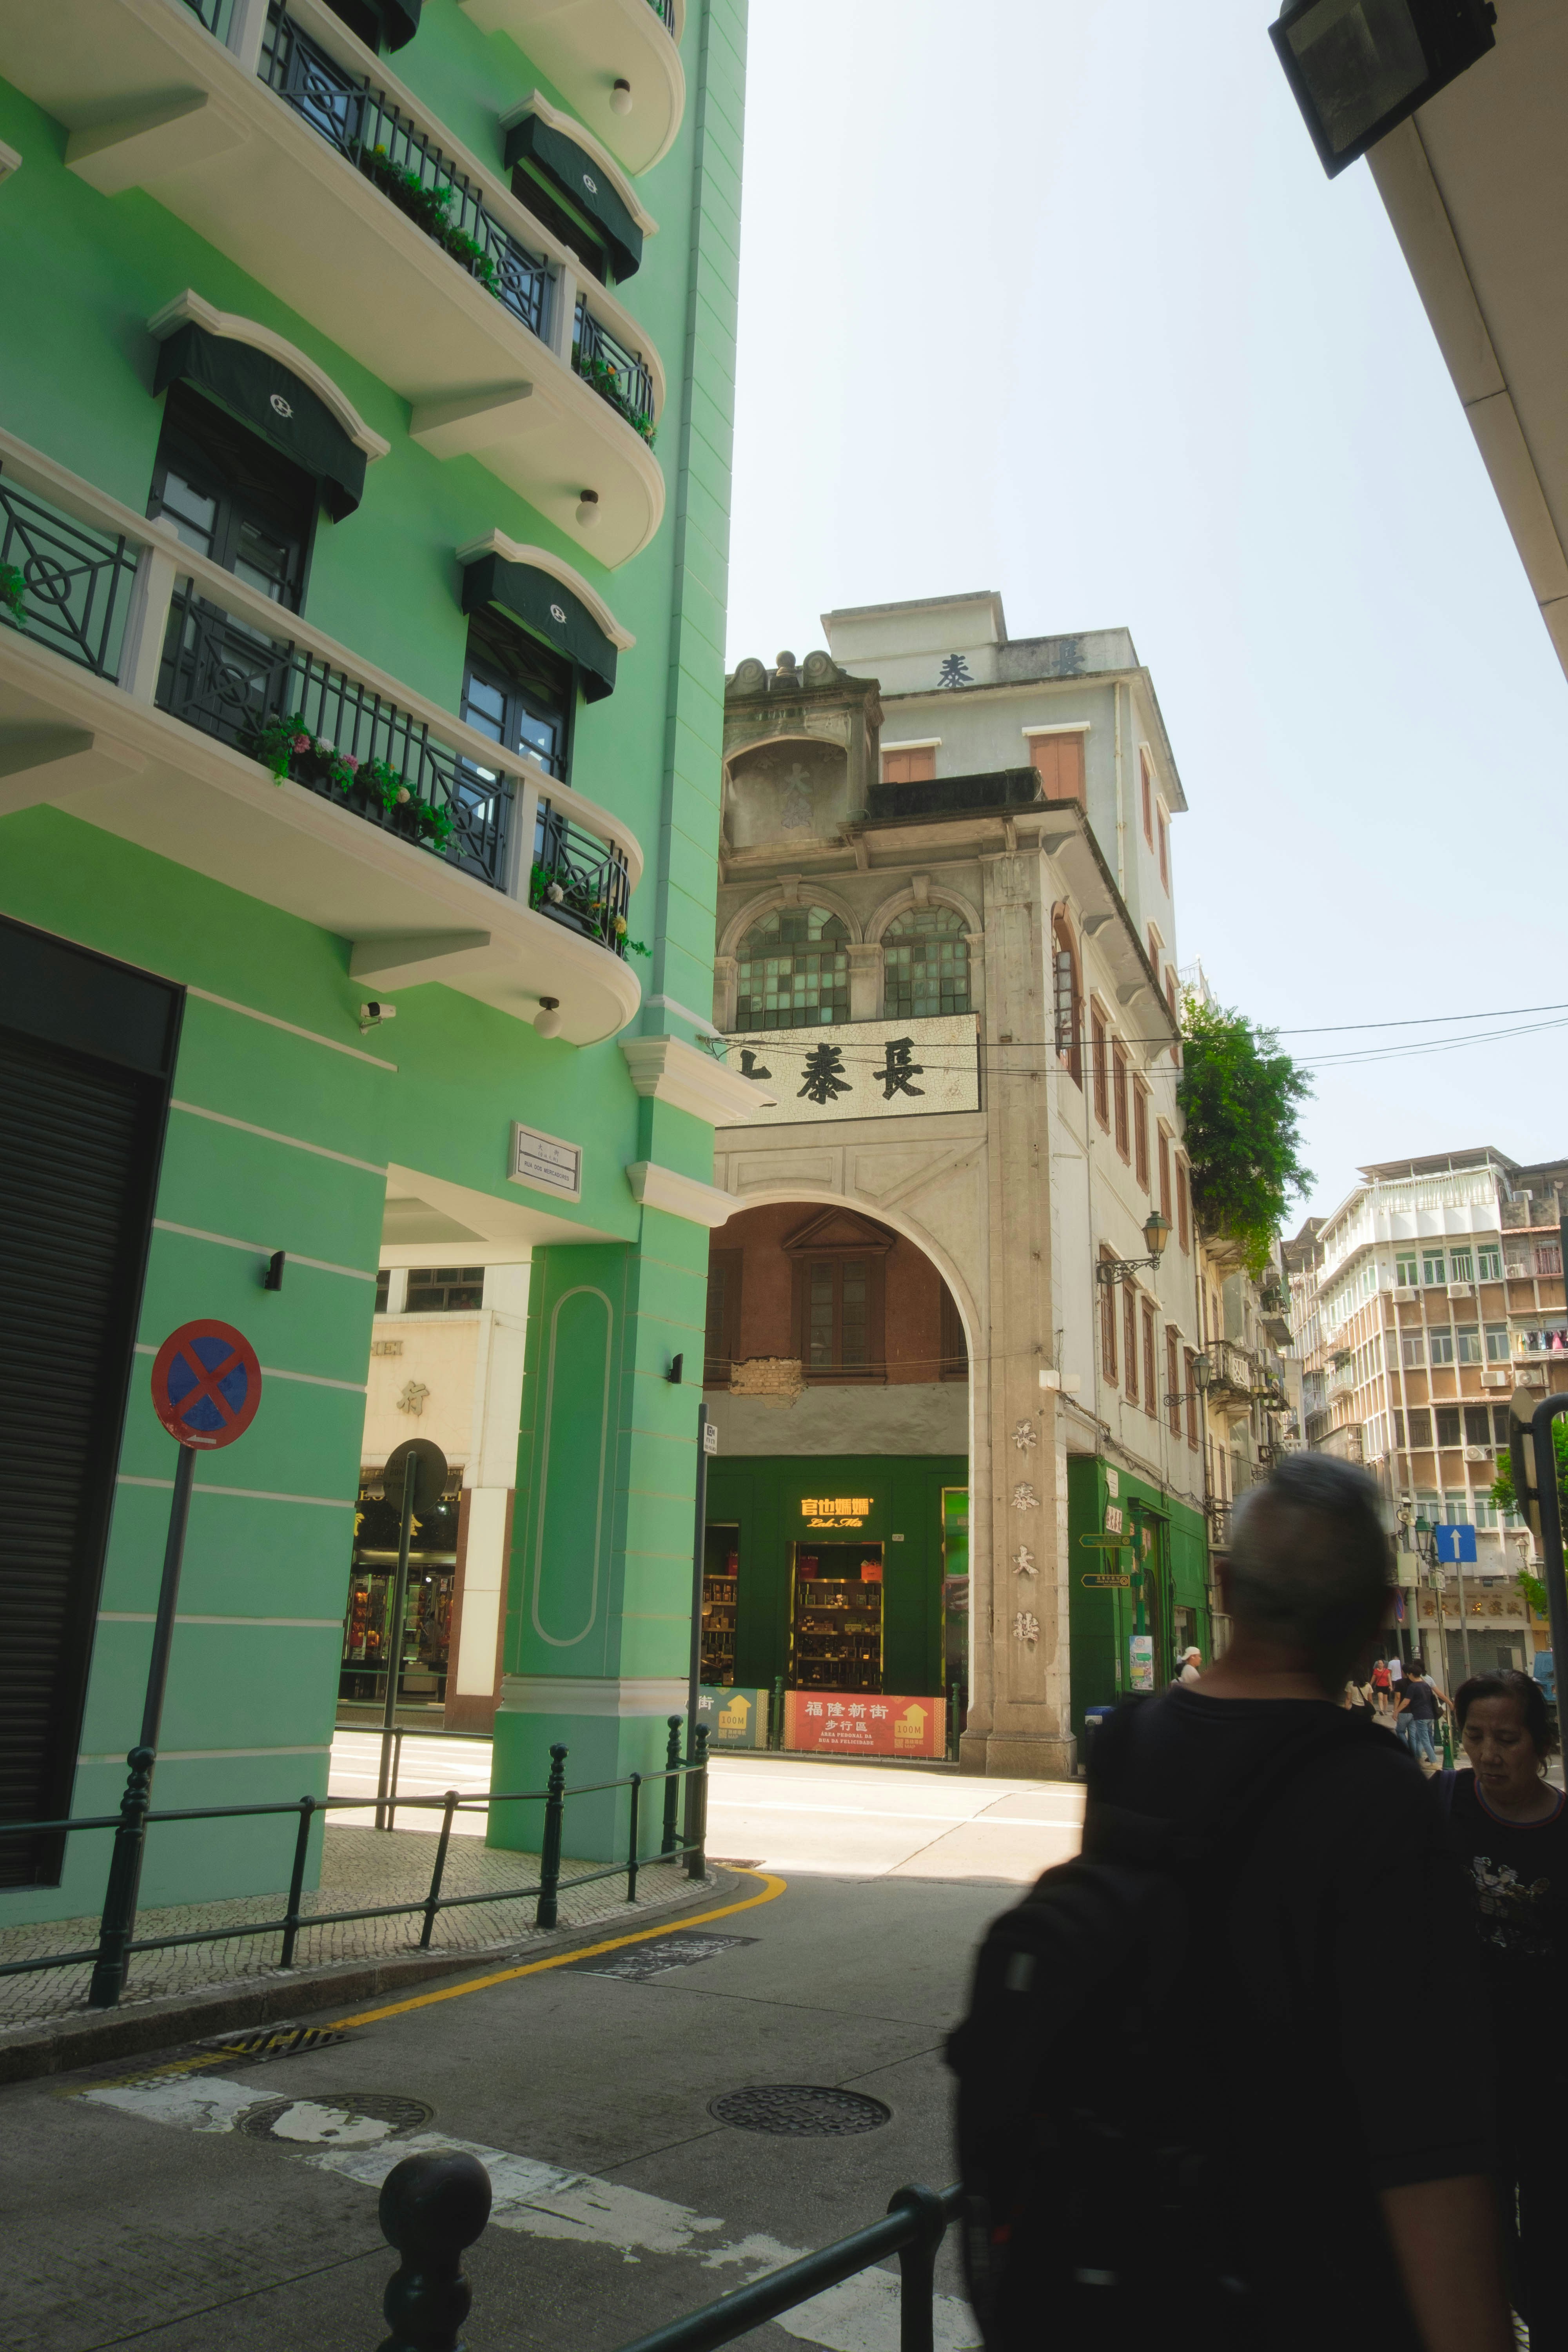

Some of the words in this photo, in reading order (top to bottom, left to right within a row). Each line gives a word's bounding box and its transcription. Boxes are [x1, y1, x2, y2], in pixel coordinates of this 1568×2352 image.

[544, 1168, 569, 1181] MERCADORES
[396, 1380, 430, 1416] 行
[801, 1498, 869, 1516] 官也媽媽
[805, 1700, 889, 1719] 福隆新街
[722, 1716, 744, 1724] 100M
[825, 1720, 868, 1732] 步行區
[897, 1724, 921, 1734] 100M
